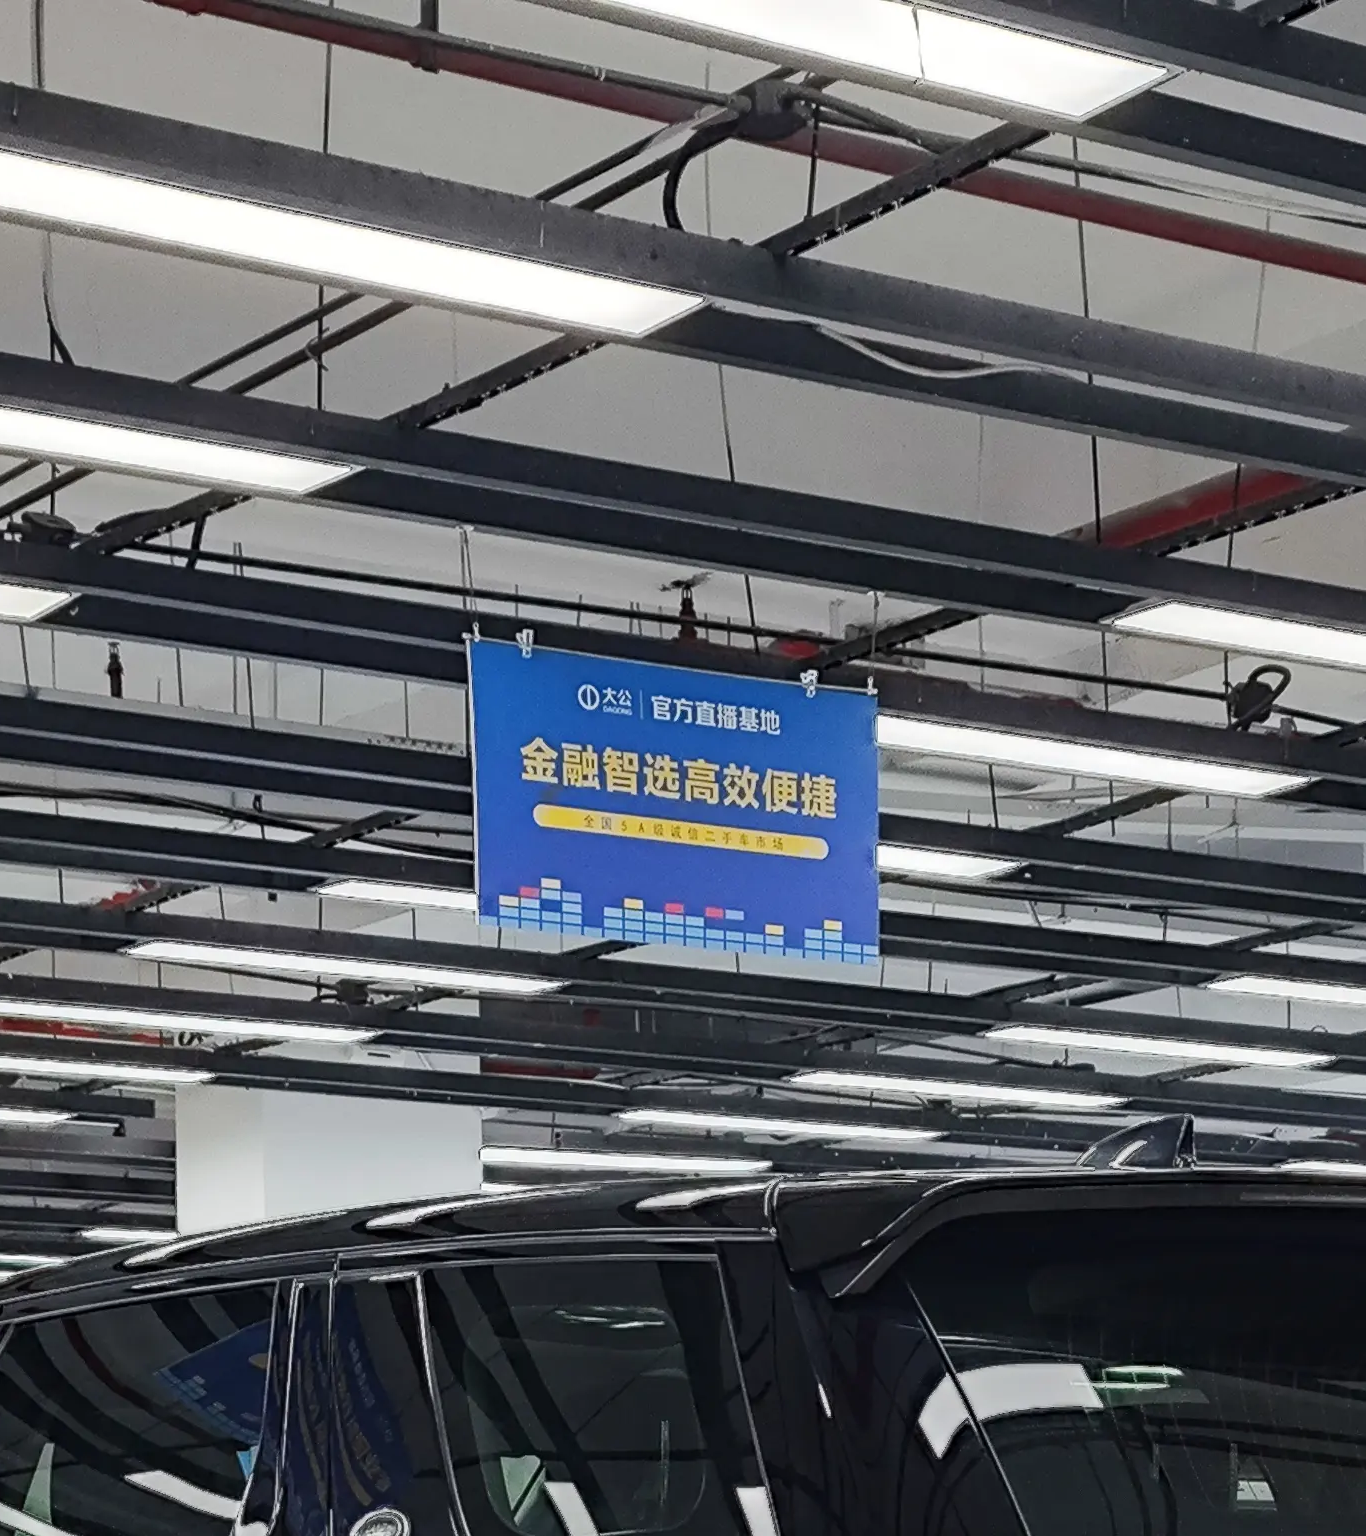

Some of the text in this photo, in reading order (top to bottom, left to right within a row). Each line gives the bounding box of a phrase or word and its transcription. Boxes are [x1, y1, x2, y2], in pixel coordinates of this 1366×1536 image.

[602, 687, 633, 708] 大公
[651, 695, 781, 736] 官方直播基地
[520, 737, 837, 819] 金融智选高效便捷
